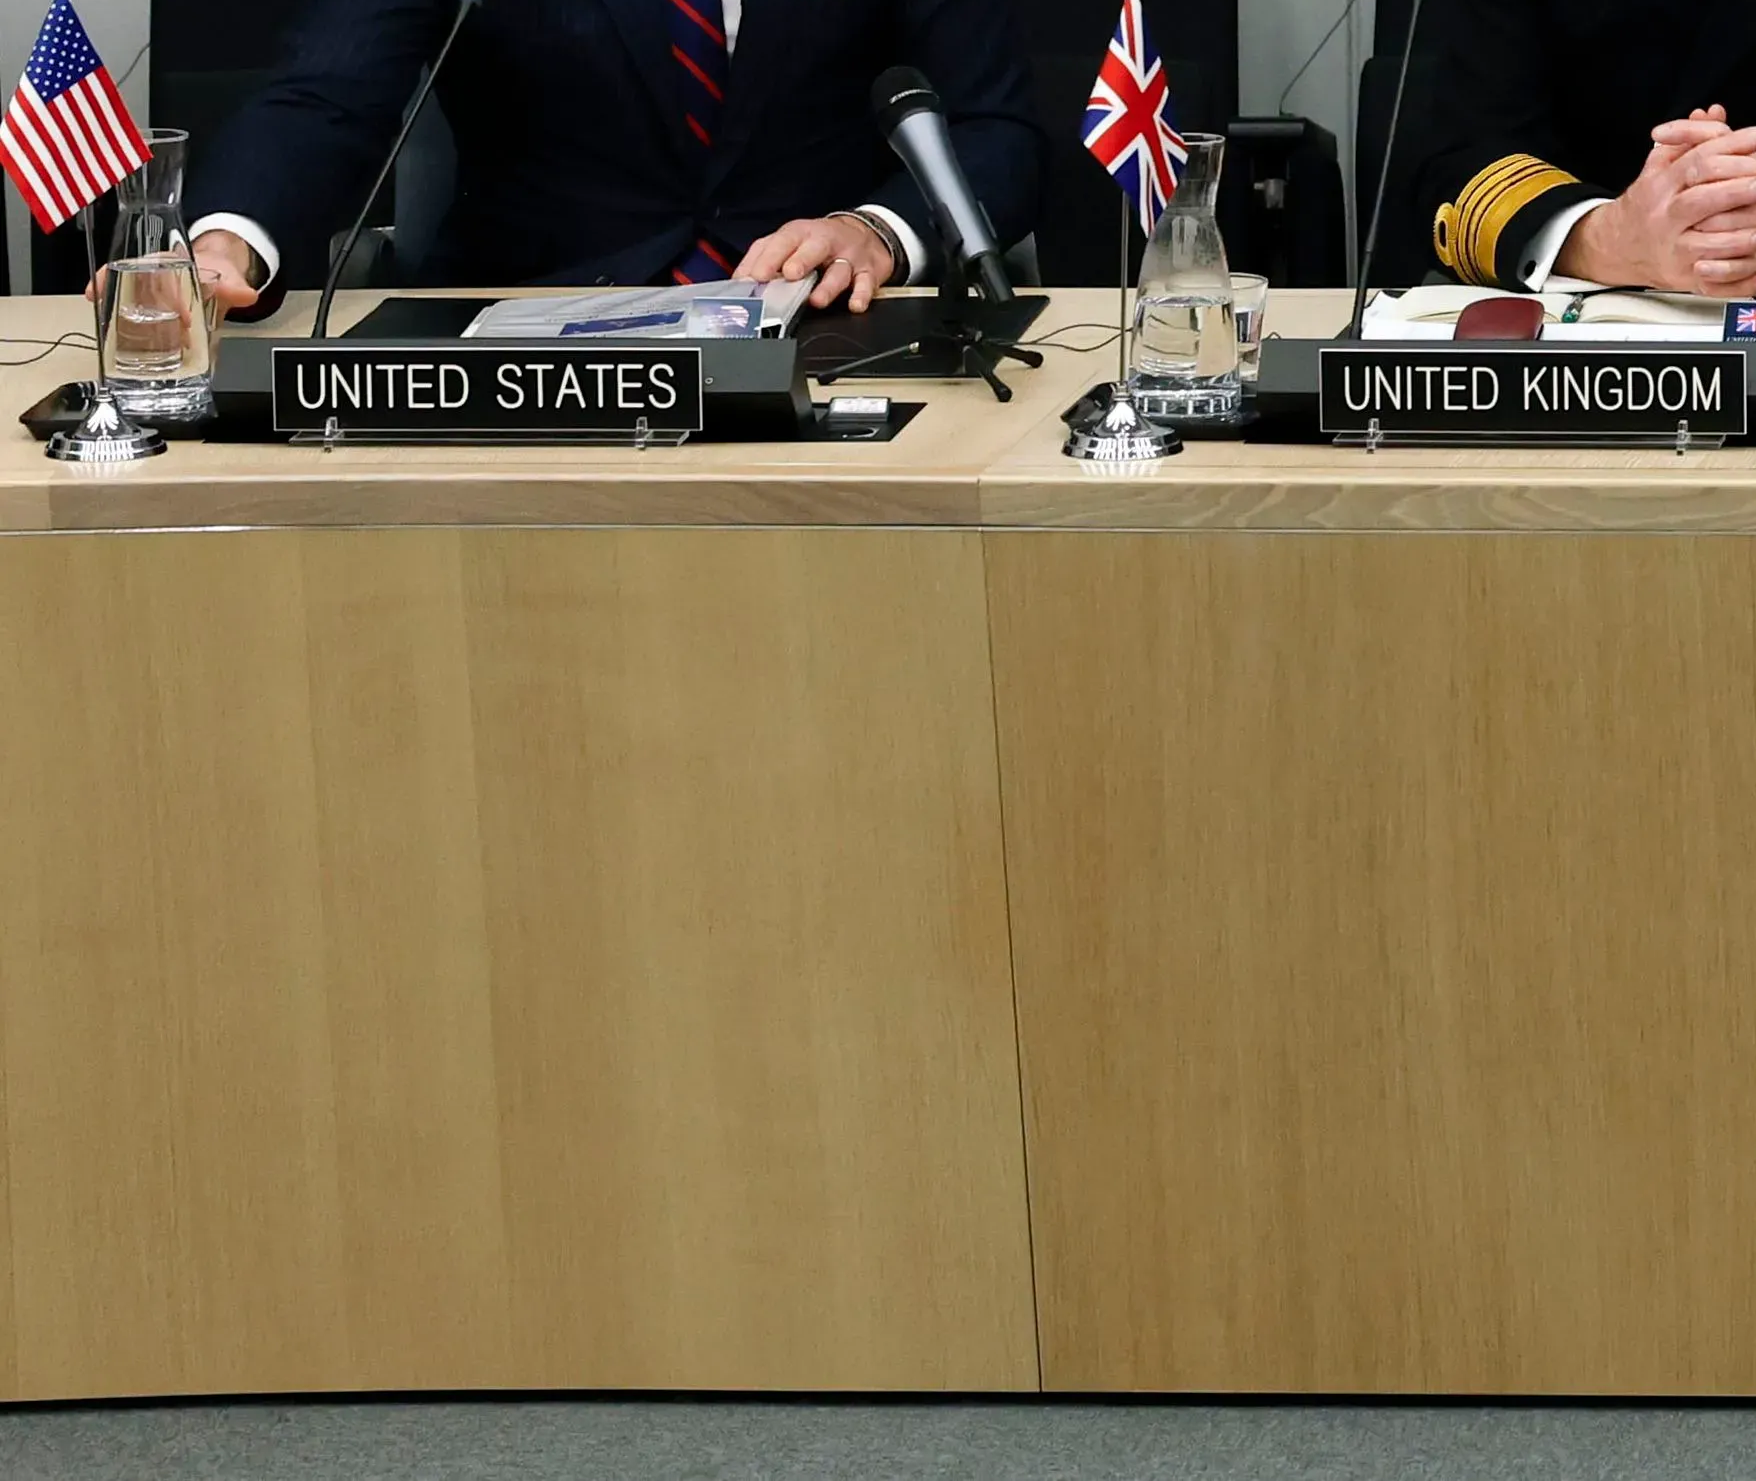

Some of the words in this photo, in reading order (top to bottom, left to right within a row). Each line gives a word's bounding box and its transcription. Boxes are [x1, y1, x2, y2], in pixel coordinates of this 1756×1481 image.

[297, 363, 469, 410] UNITED
[496, 363, 677, 410] STATES
[1344, 365, 1499, 411] UNITED
[1523, 365, 1721, 411] KINGDOM
